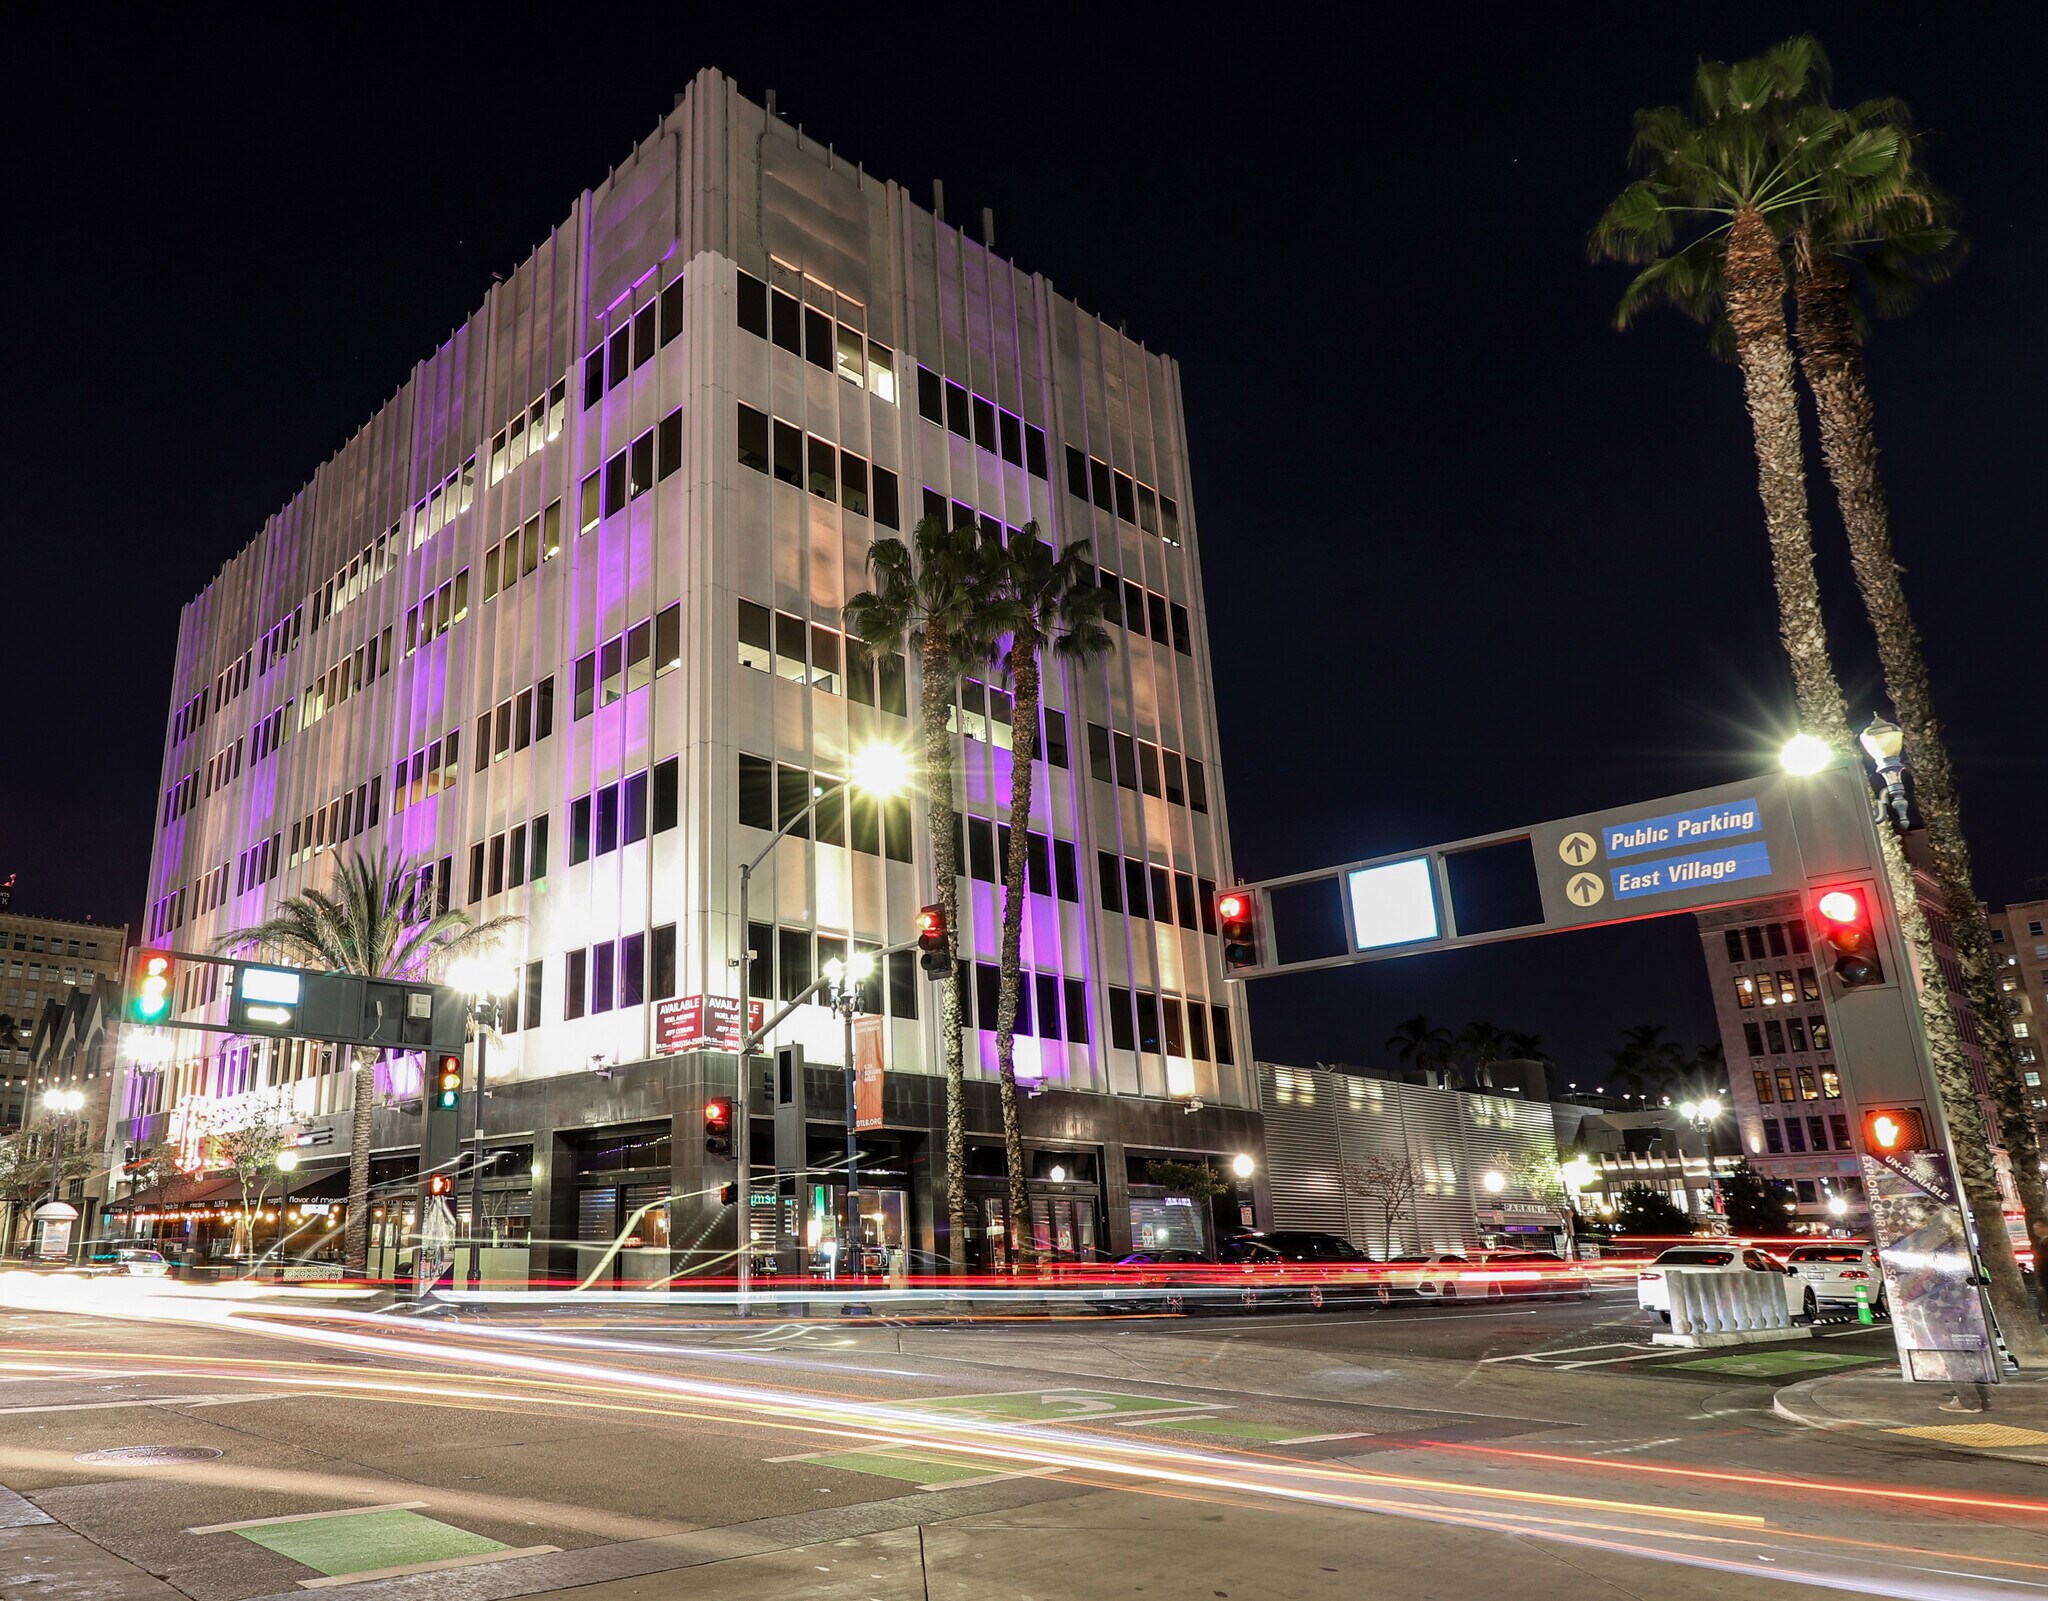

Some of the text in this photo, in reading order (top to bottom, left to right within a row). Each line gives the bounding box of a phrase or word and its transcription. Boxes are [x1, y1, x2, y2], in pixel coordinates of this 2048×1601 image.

[1611, 811, 1754, 850] Public Parking
[1619, 859, 1736, 892] East Village
[660, 998, 700, 1015] AVAILABLE
[708, 998, 760, 1014] AVAILALE
[856, 1117, 882, 1128] DTLB.ORG
[1861, 1155, 1880, 1201] EXPLORE
[1884, 1155, 1950, 1201] UN-DENIABLE
[289, 1195, 309, 1204] flavor
[311, 1195, 319, 1204] of
[320, 1196, 348, 1204] mexico
[1504, 1204, 1546, 1214] PARKING
[1872, 1203, 1887, 1227] OUR
[1877, 1229, 1890, 1248] 1.38
